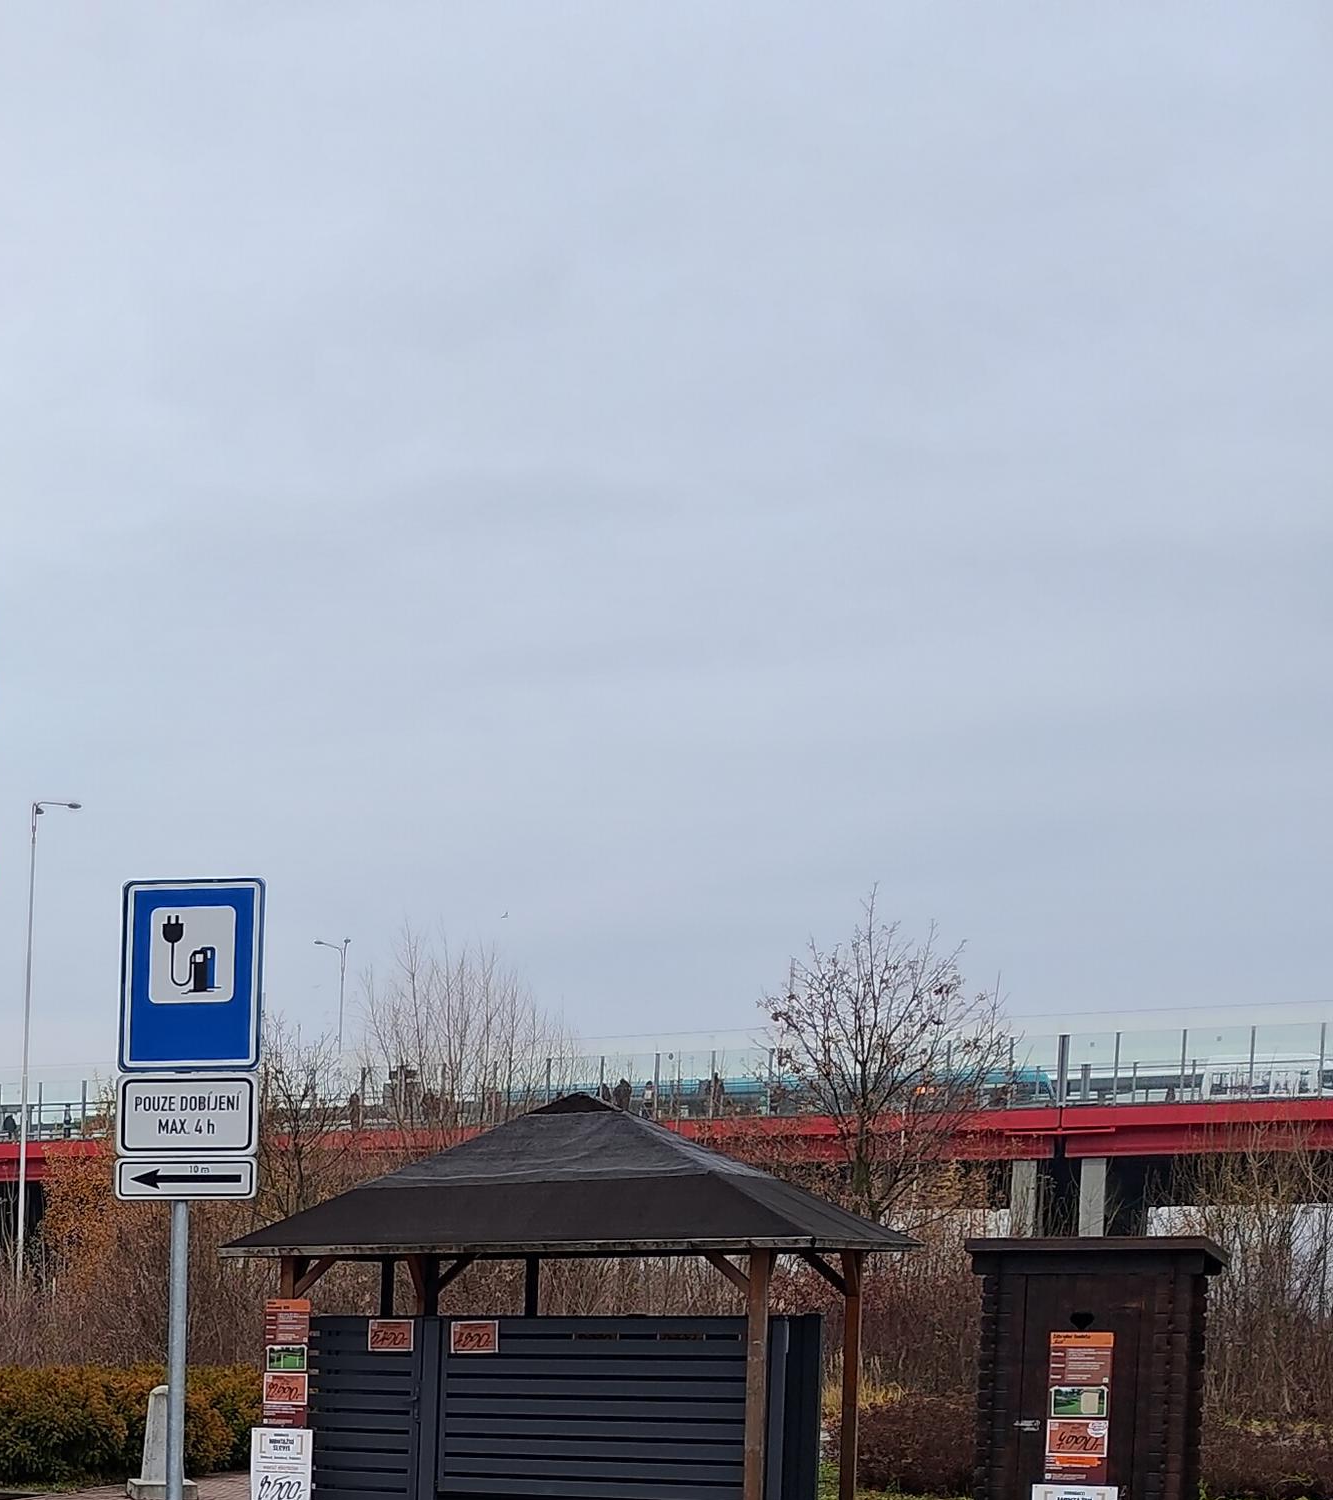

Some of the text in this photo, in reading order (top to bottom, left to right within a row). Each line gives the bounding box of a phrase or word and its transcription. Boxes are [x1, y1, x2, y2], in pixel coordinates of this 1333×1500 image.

[134, 1090, 242, 1111] POUZE DOBÍJENÍ
[158, 1119, 215, 1134] MAX. 4 h
[189, 1165, 199, 1173] 10
